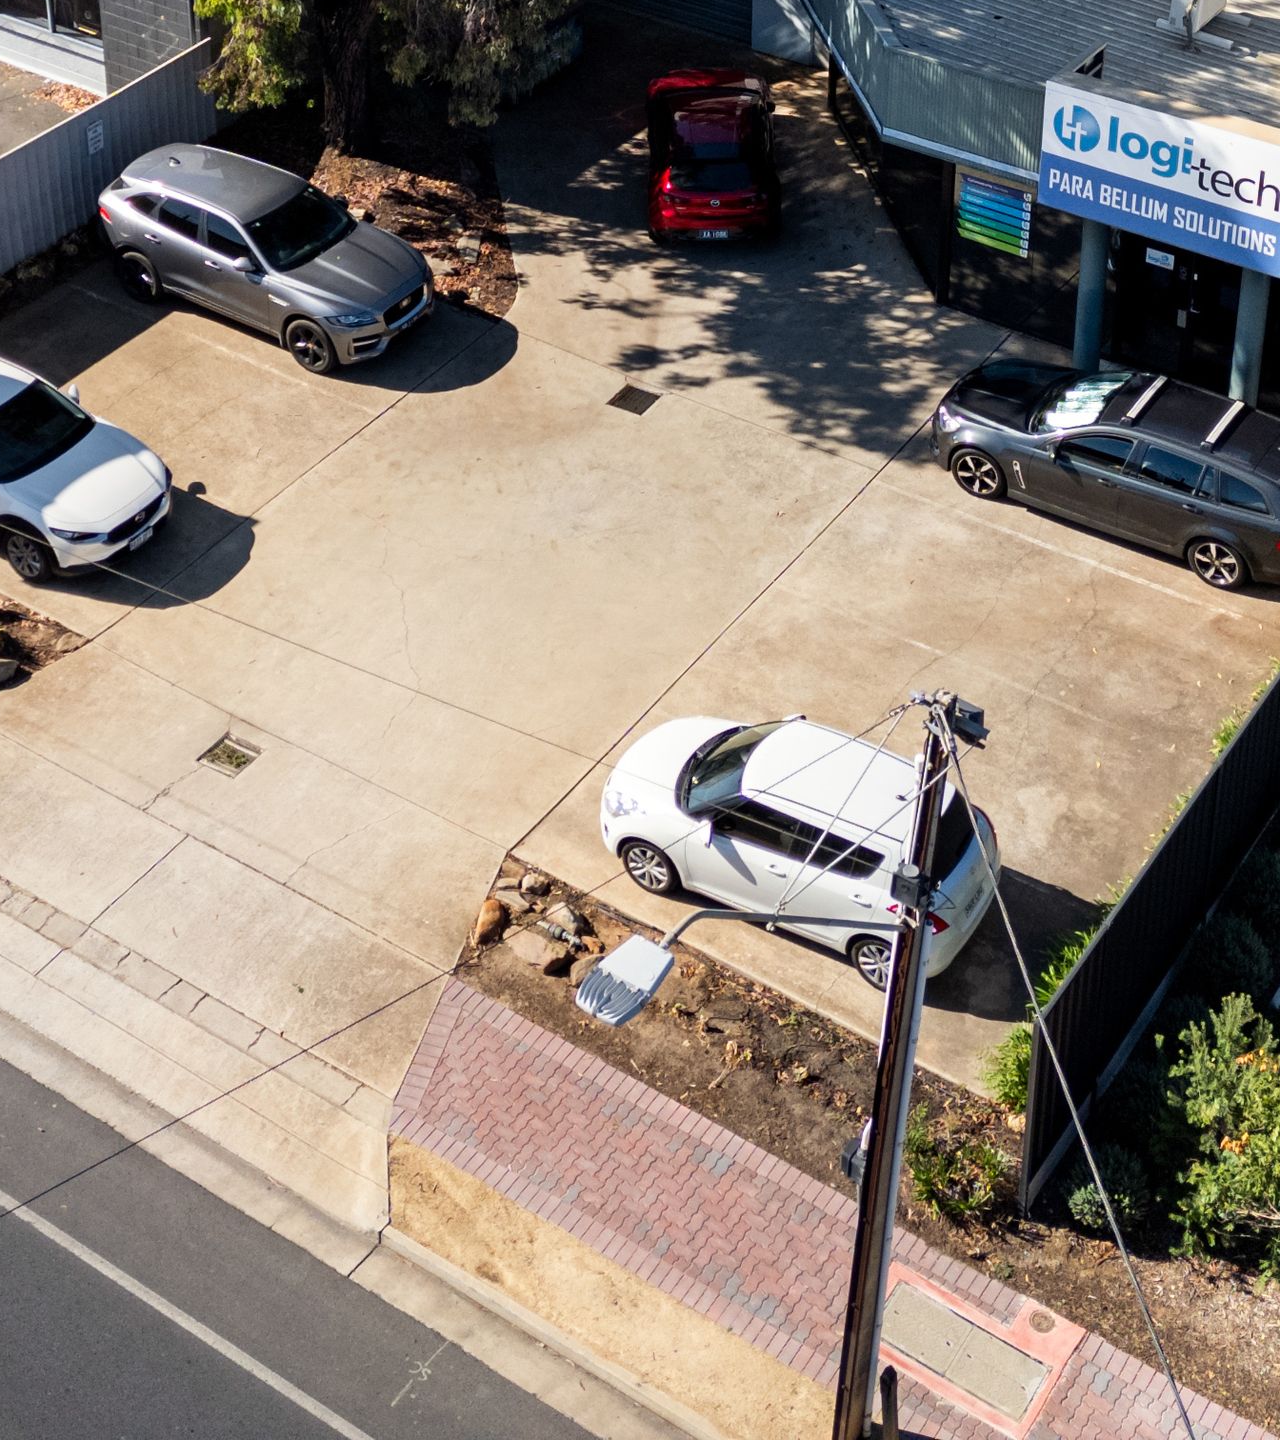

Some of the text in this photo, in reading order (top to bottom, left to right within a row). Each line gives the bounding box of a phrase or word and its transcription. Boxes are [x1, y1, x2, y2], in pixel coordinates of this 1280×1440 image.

[1049, 168, 1277, 257] PARA BELLUM SOLUTIONS
